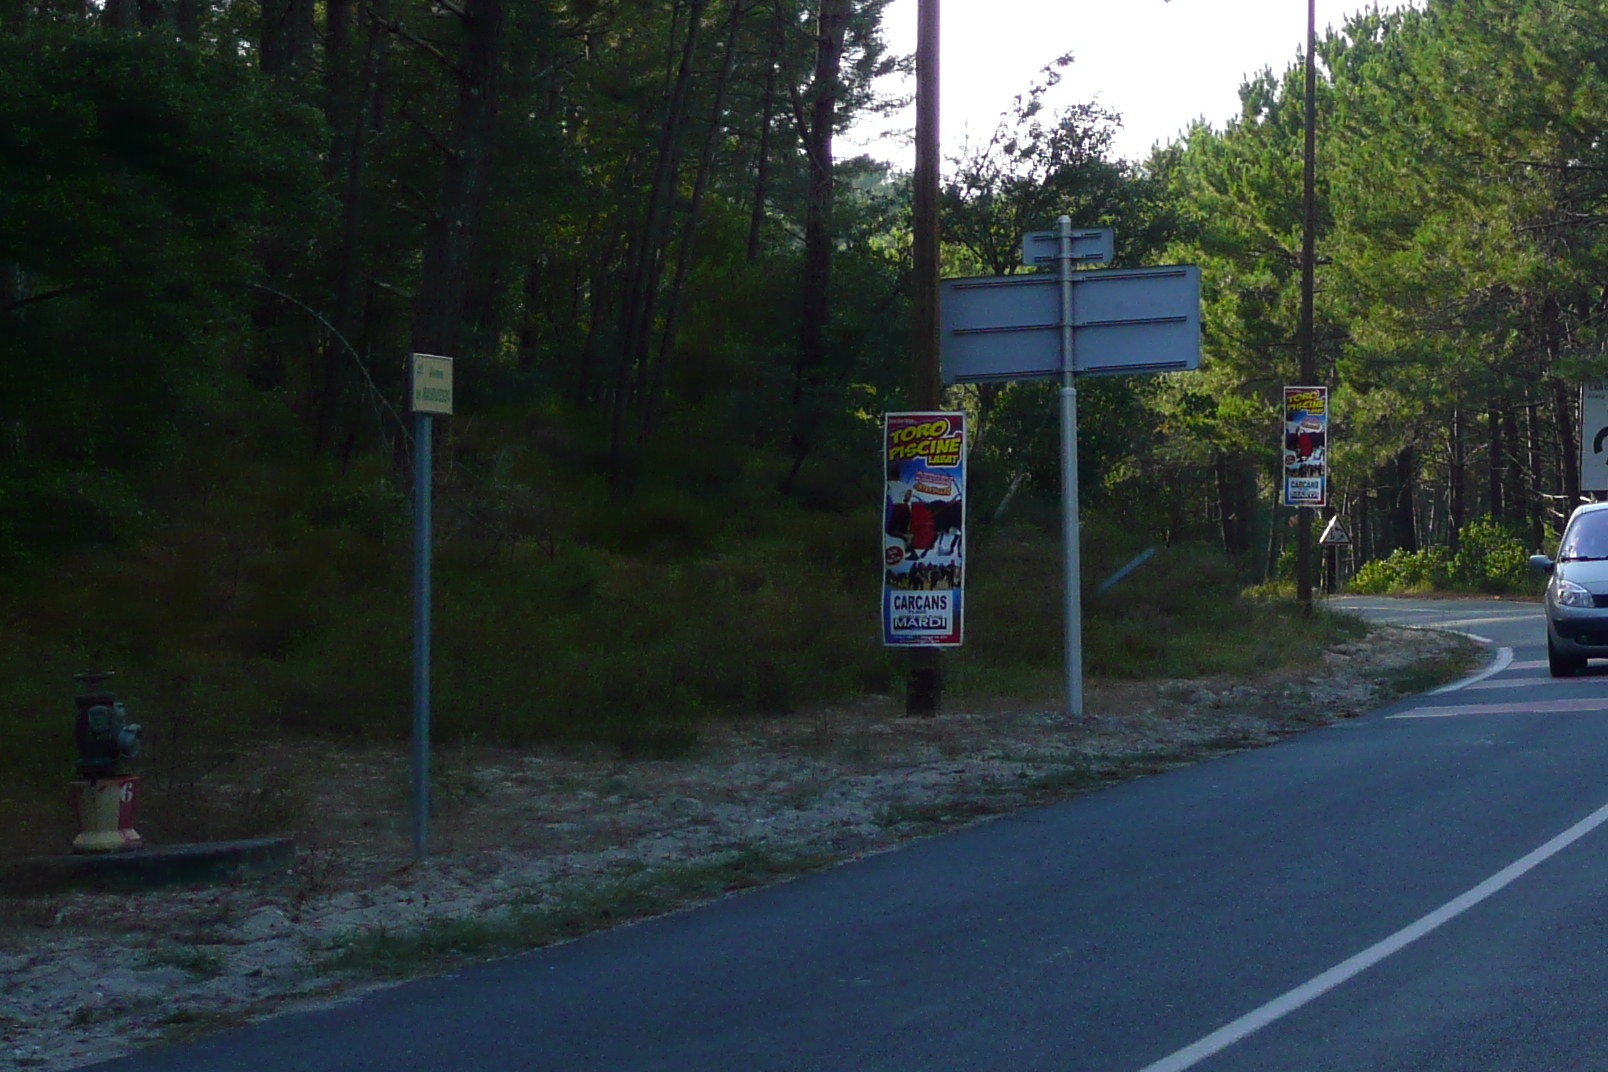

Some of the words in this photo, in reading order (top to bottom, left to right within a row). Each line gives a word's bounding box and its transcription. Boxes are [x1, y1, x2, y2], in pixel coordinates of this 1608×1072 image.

[1289, 391, 1318, 403] TORO
[890, 420, 948, 444] TORO
[888, 438, 961, 461] PISCINE
[893, 594, 947, 611] CARCANS
[894, 617, 946, 628] MARDI
[121, 782, 133, 803] 6
